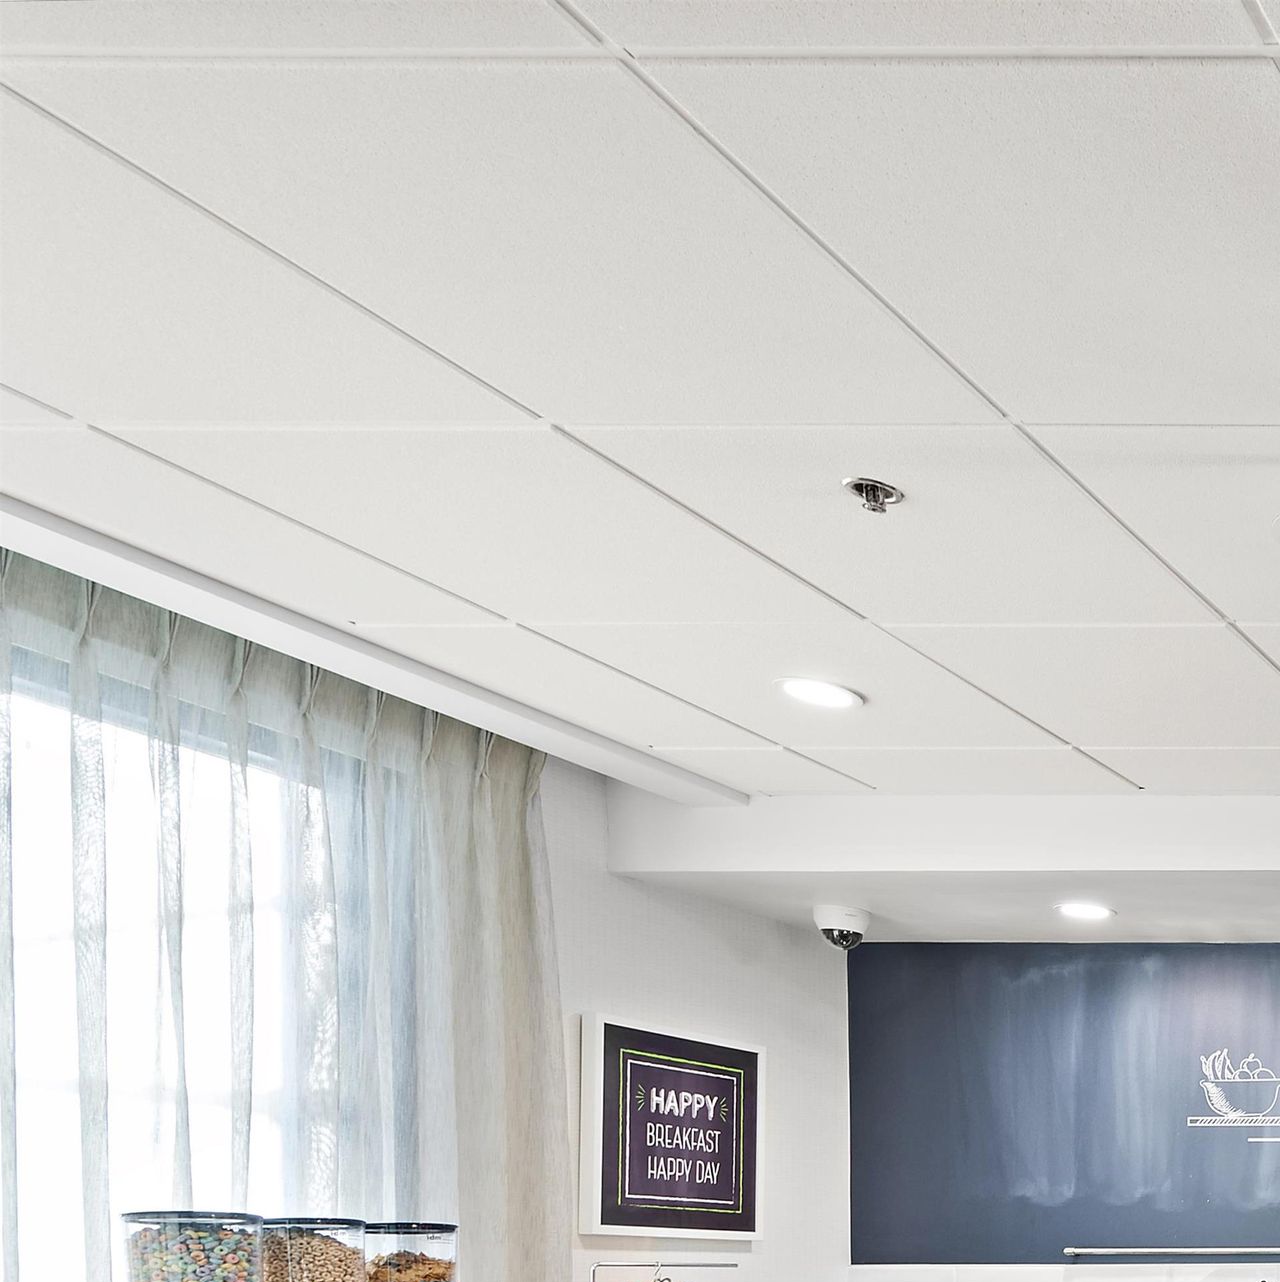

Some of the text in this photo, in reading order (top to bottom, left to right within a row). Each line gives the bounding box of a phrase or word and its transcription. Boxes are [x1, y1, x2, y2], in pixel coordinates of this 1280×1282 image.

[650, 1087, 718, 1121] HAPPY
[646, 1122, 721, 1153] BREAKFAST
[647, 1155, 720, 1185] HAPPY DAY
